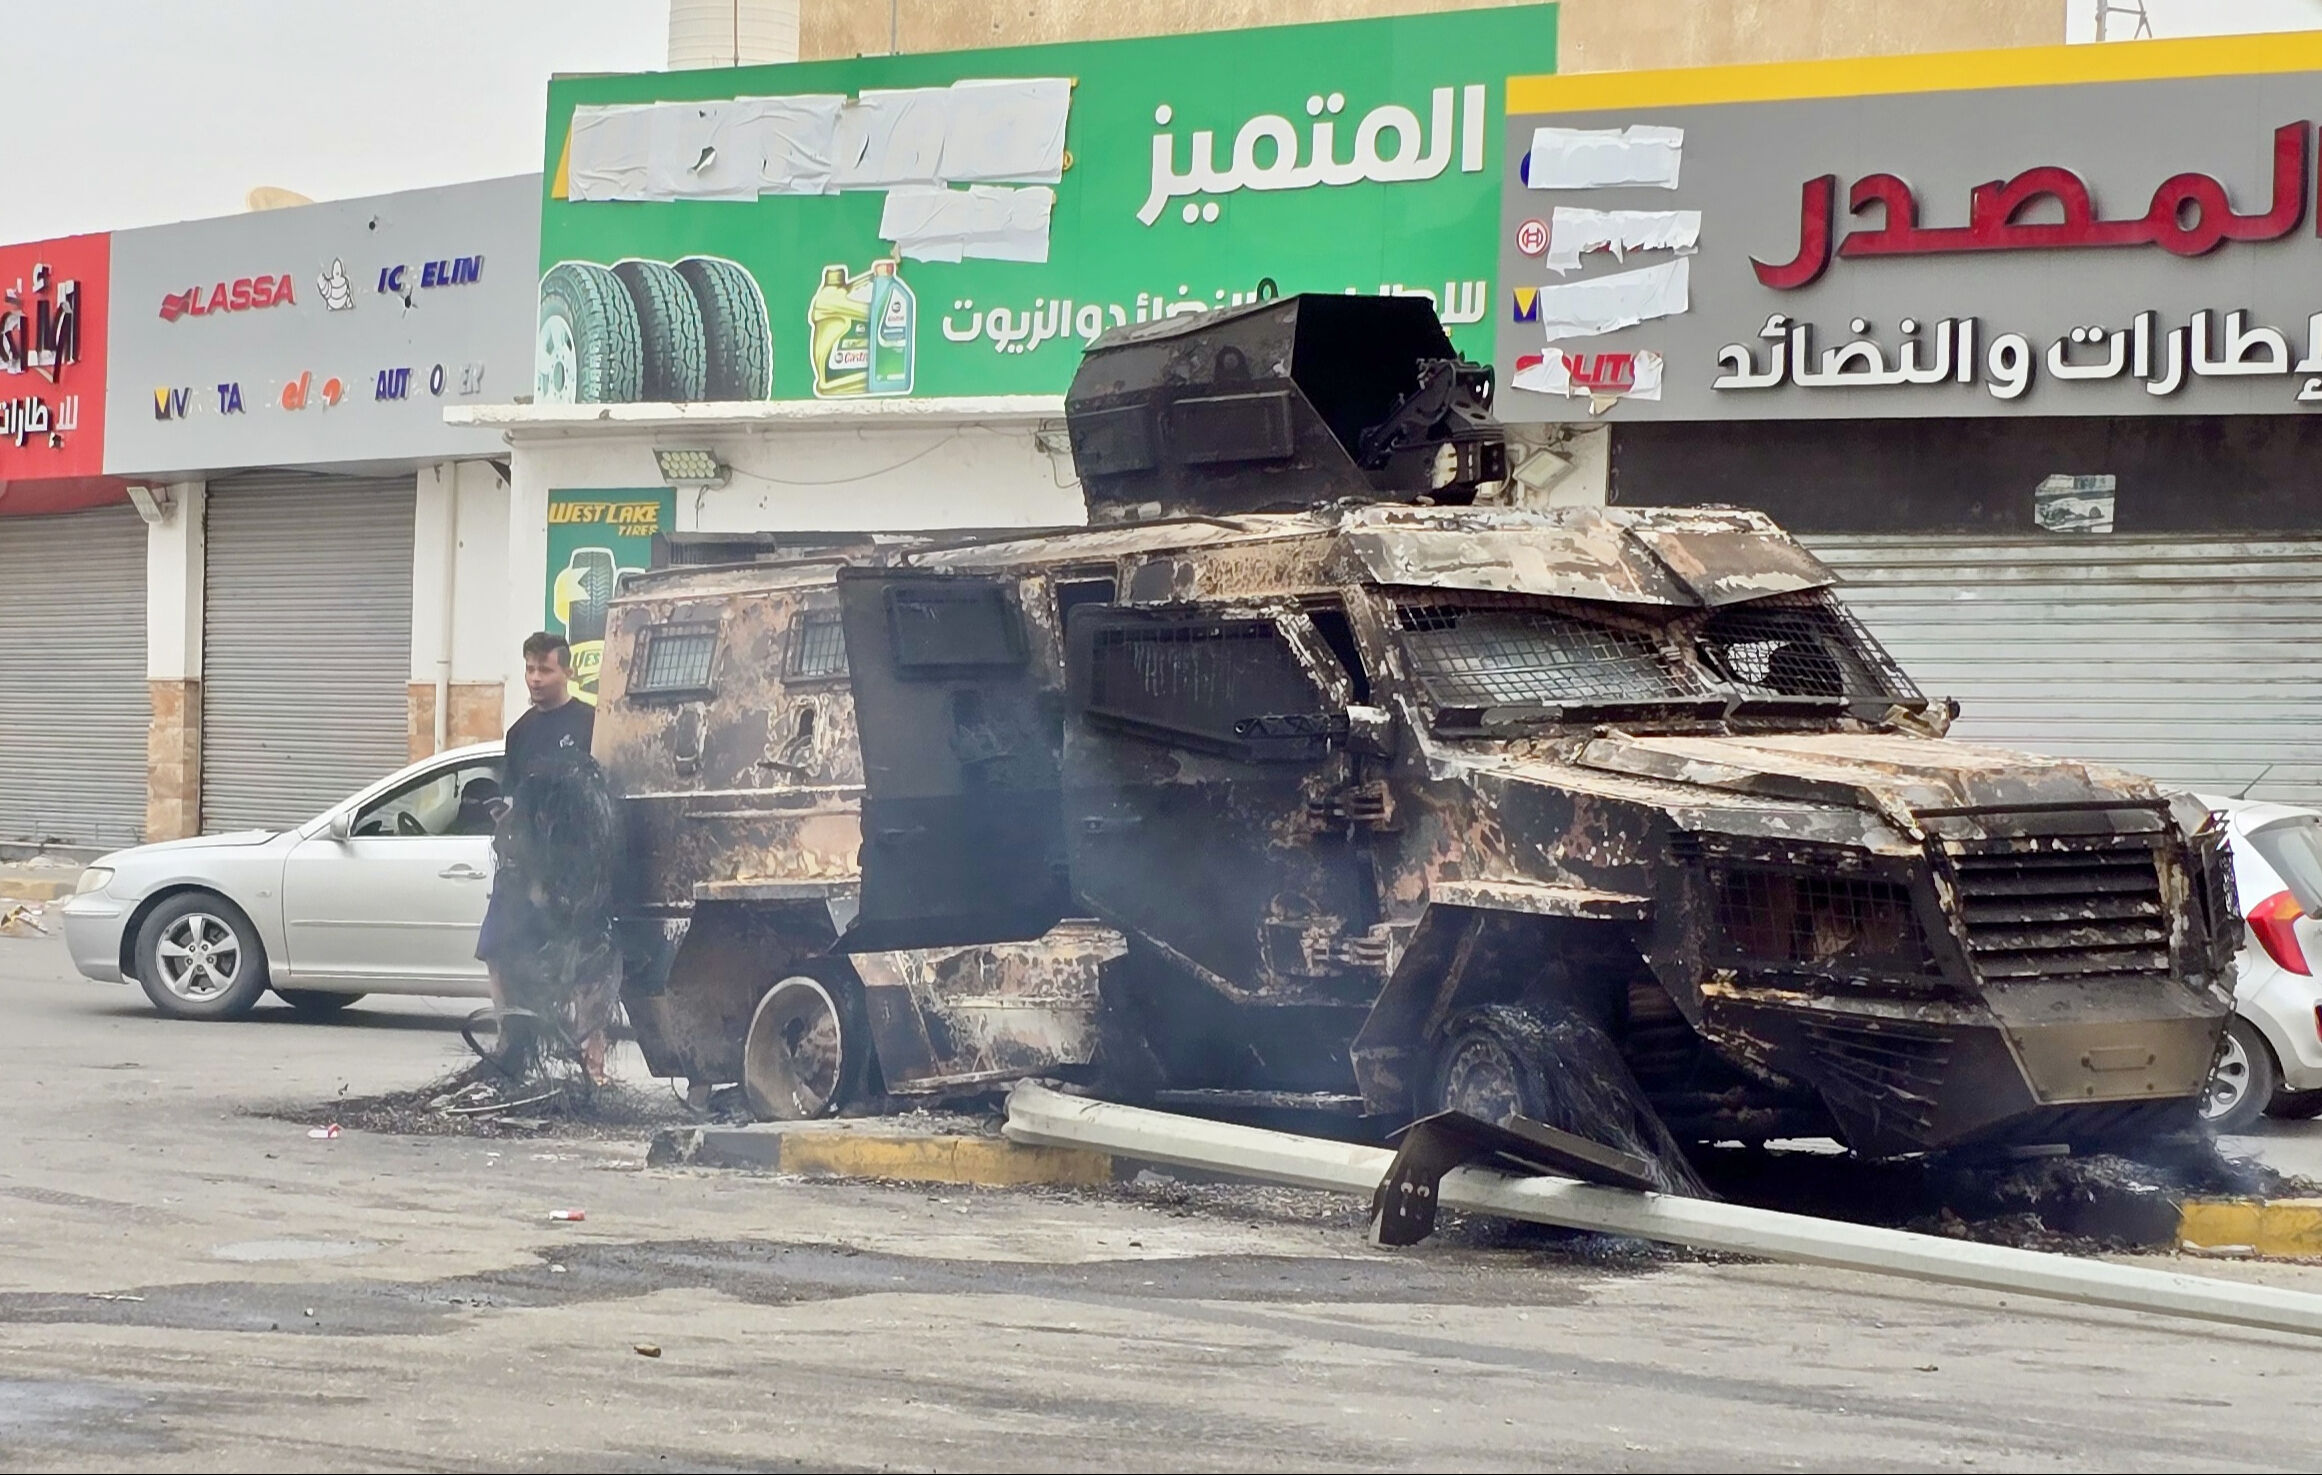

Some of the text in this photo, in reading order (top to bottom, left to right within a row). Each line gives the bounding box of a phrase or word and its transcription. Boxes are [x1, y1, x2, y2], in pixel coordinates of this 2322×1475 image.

[1136, 84, 1486, 227] المتميز
[1749, 118, 2322, 290] لمصدر
[189, 274, 296, 316] LASSA
[942, 298, 1103, 355] والزيوت
[1712, 311, 2036, 400] والنضائد
[617, 525, 659, 537] TIRES
